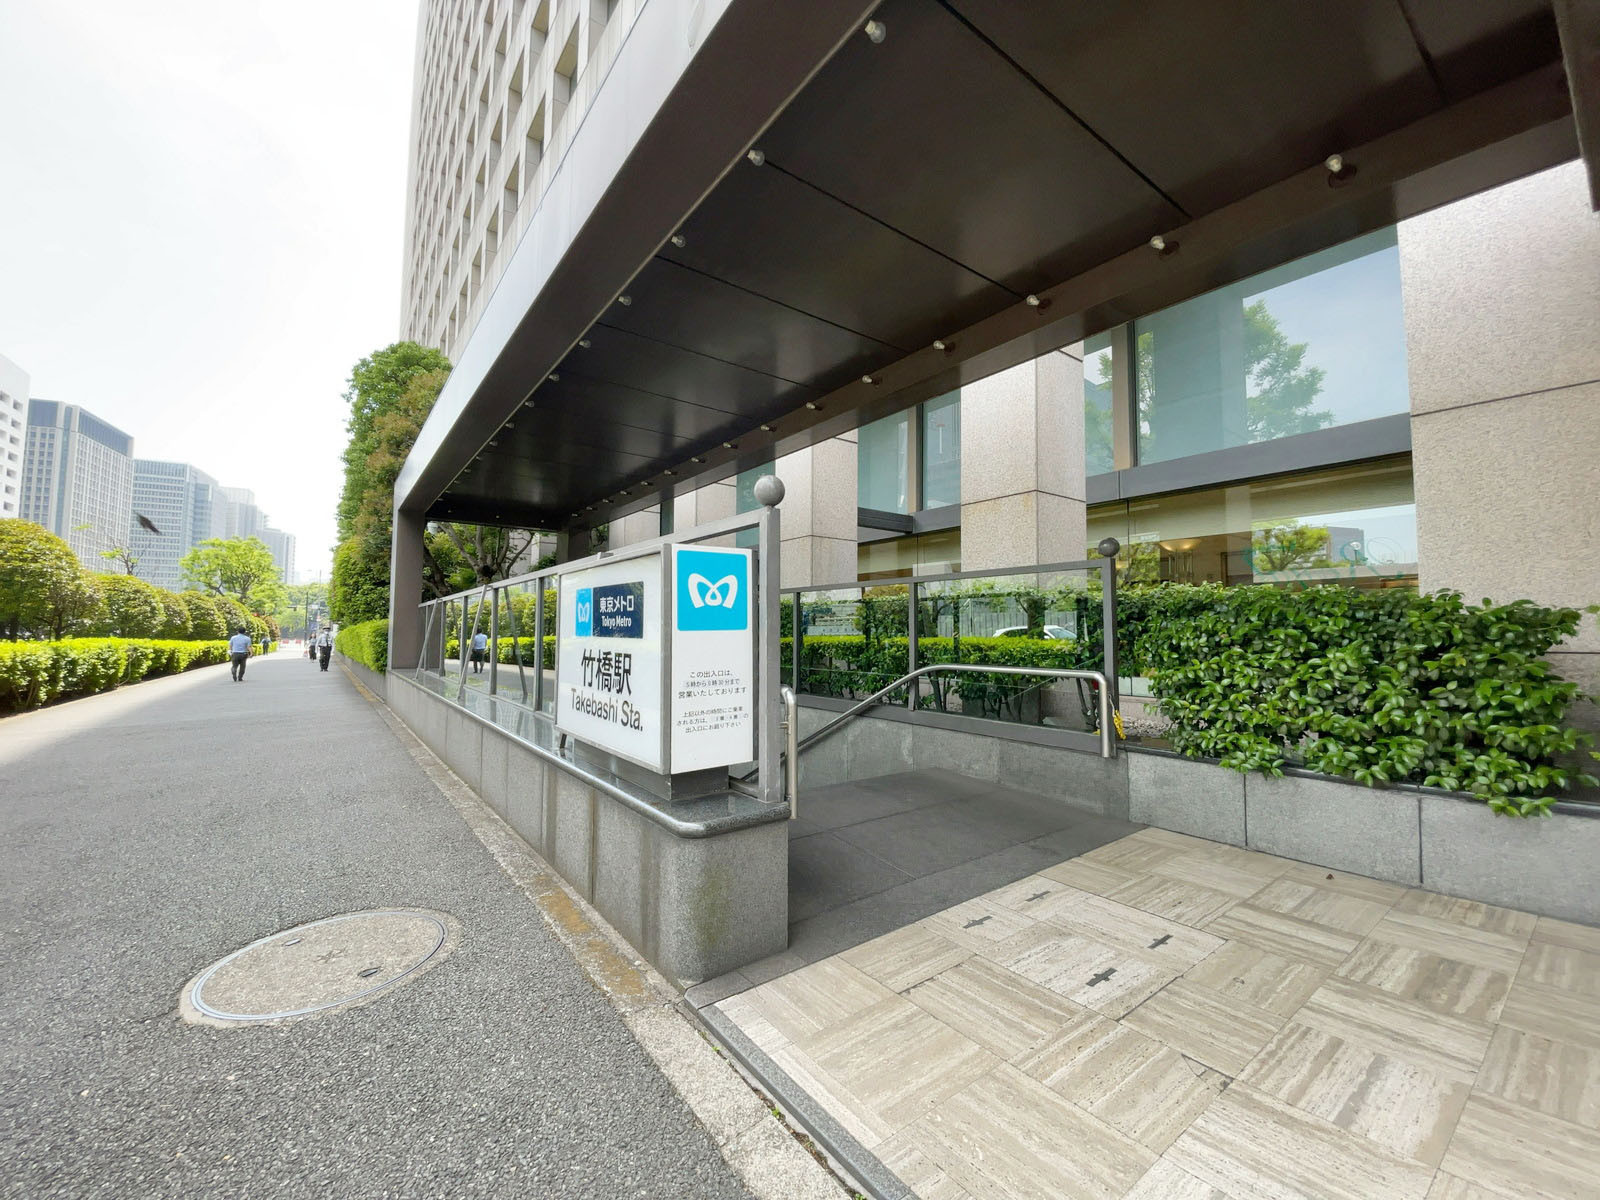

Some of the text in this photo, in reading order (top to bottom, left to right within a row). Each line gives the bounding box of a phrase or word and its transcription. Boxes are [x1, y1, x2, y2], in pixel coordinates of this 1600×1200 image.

[600, 595, 634, 613] 東京メトロ
[601, 615, 632, 629] Tokyo Metro
[581, 648, 632, 696] 竹橋駅
[571, 688, 644, 732] Takebashi Sta.
